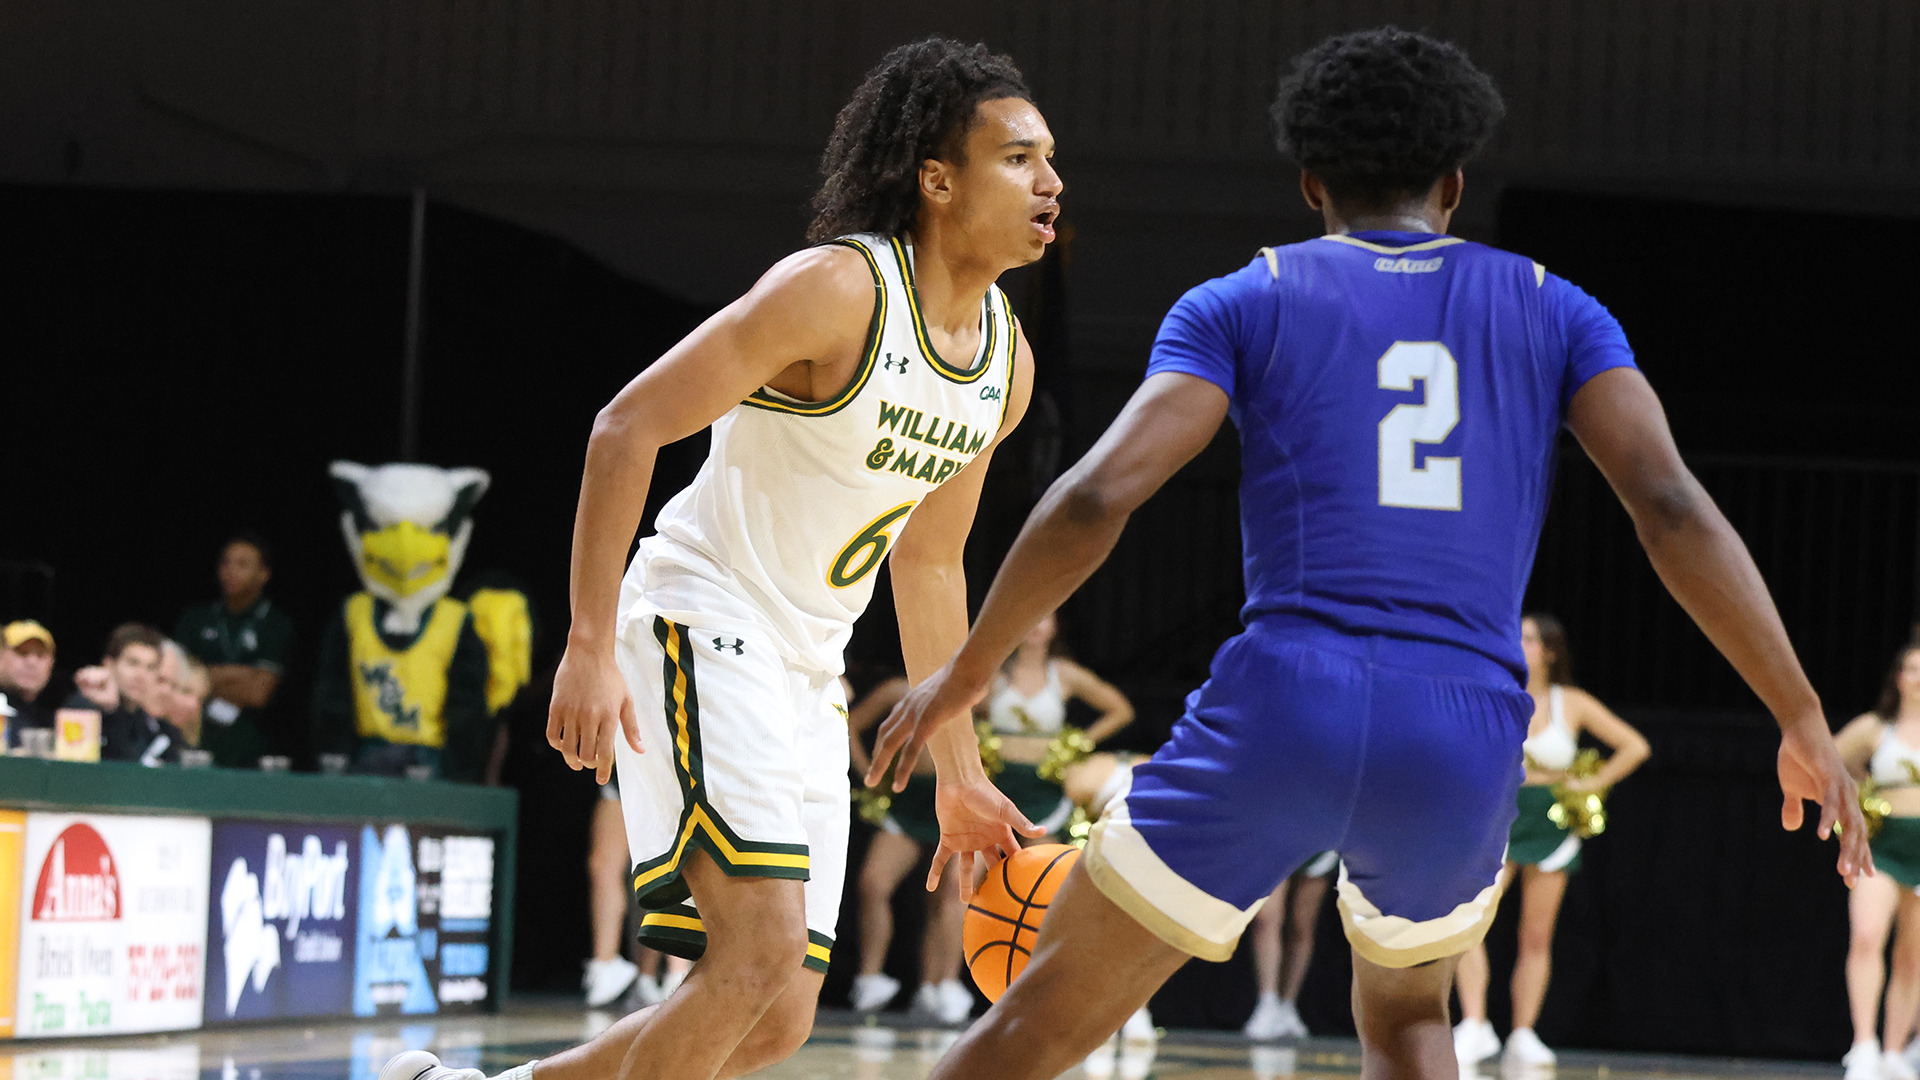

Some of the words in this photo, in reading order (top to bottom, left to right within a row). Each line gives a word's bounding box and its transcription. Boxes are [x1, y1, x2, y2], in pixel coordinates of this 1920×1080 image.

[877, 399, 987, 455] WILLIAM
[1377, 340, 1462, 511] 2
[826, 500, 917, 590] 6
